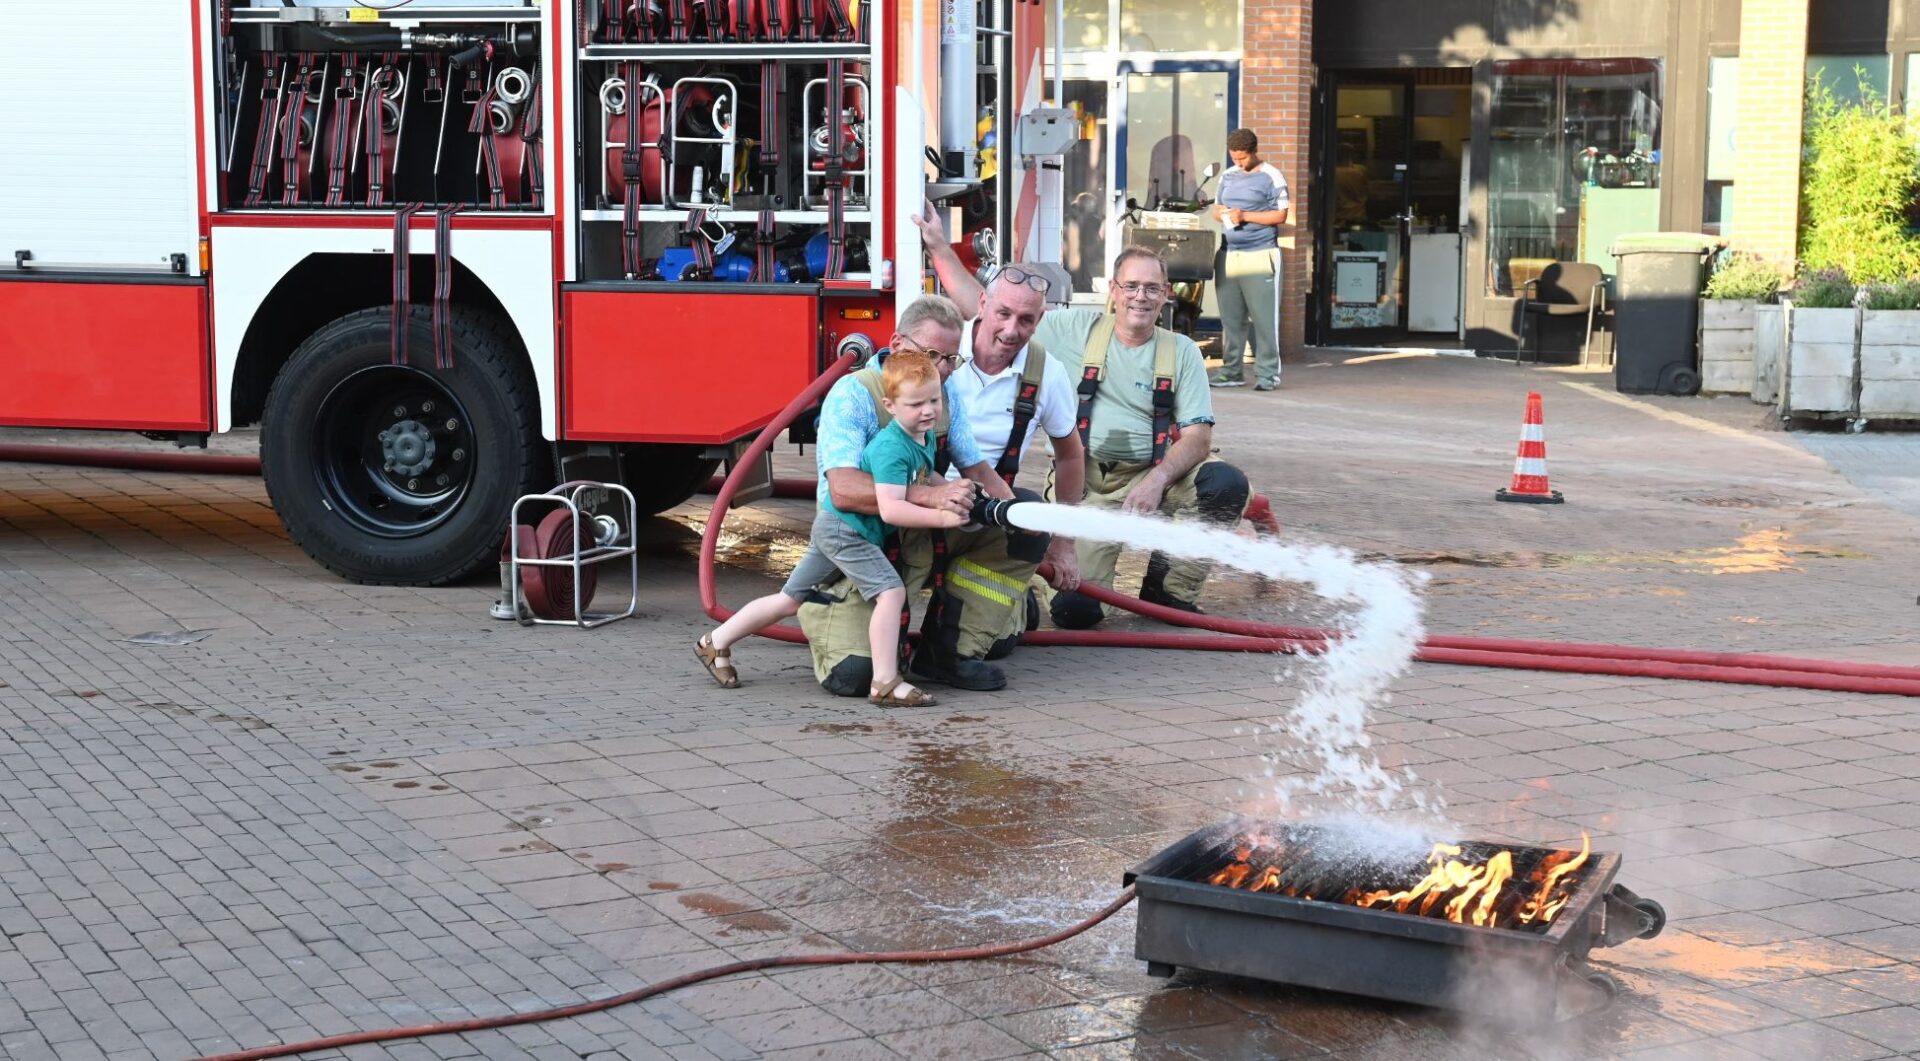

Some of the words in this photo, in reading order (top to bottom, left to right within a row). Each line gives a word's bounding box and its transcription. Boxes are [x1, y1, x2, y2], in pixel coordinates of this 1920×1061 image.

[267, 69, 274, 77] B
[301, 66, 308, 74] B
[345, 68, 352, 76] B
[430, 68, 437, 76] B
[470, 71, 477, 79] B
